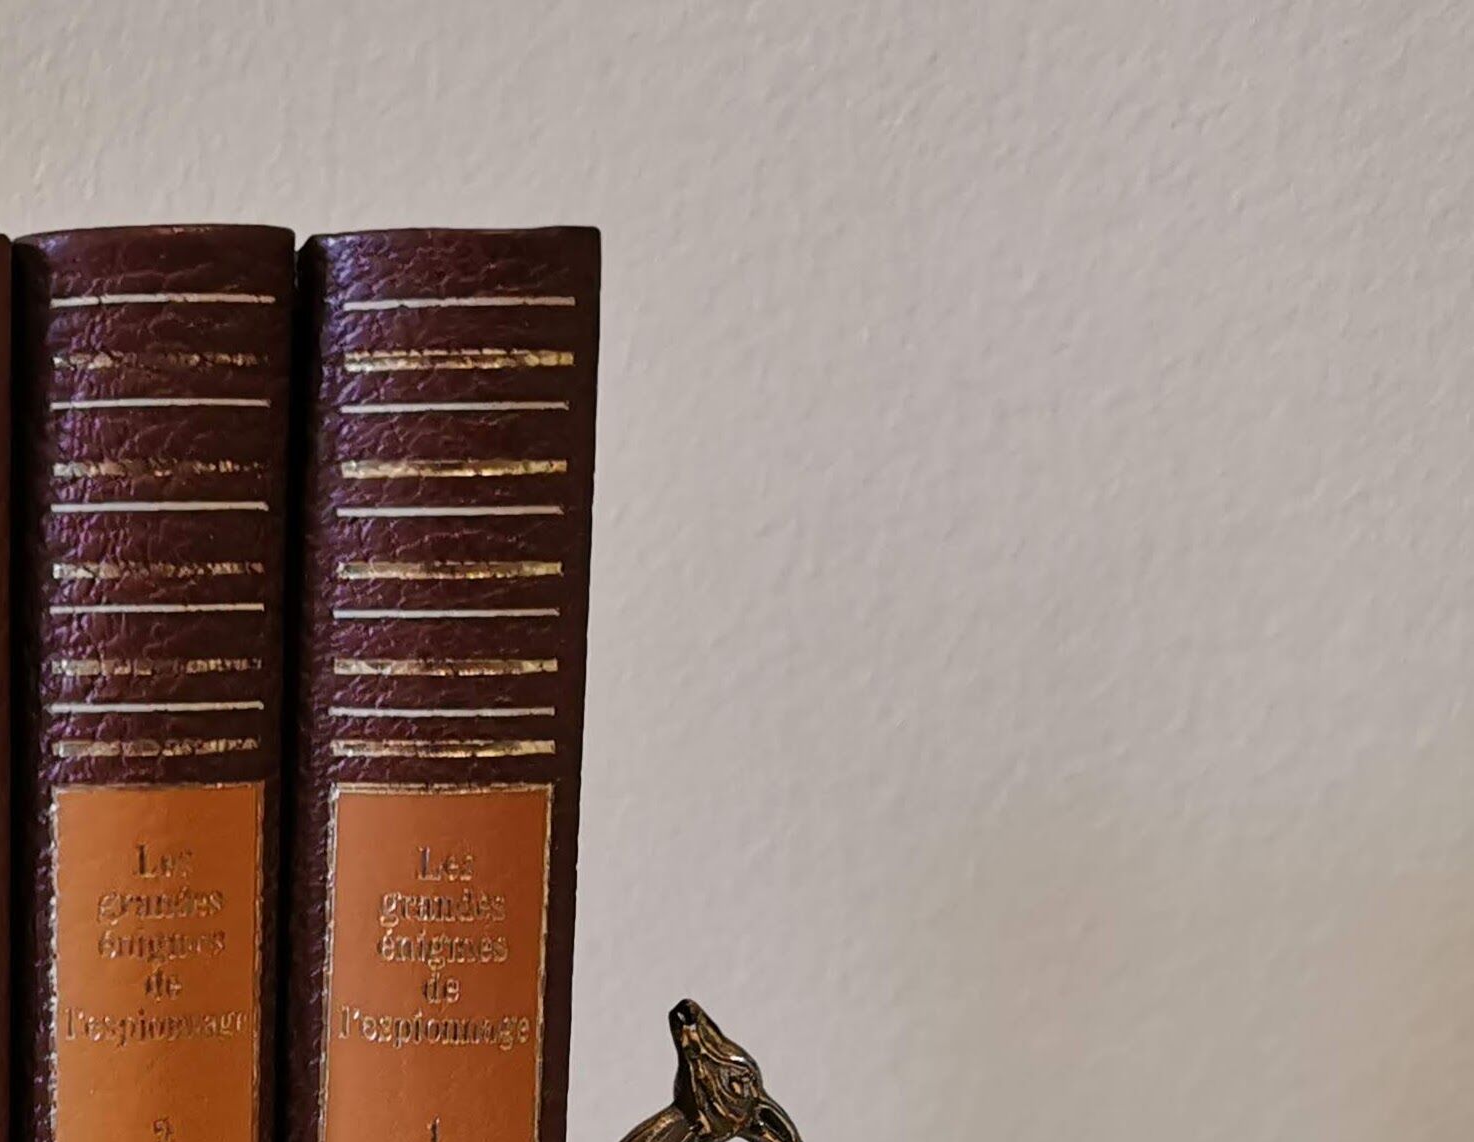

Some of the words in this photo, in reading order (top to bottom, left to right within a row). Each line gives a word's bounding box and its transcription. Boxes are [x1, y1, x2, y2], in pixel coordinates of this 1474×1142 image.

[134, 844, 194, 879] Les
[417, 846, 475, 881] Les
[97, 887, 223, 926] grandes
[380, 888, 506, 927] grandes
[380, 928, 509, 970] énigmes
[145, 966, 182, 1003] de
[424, 972, 460, 1004] de
[338, 1005, 530, 1050] l'espionnage
